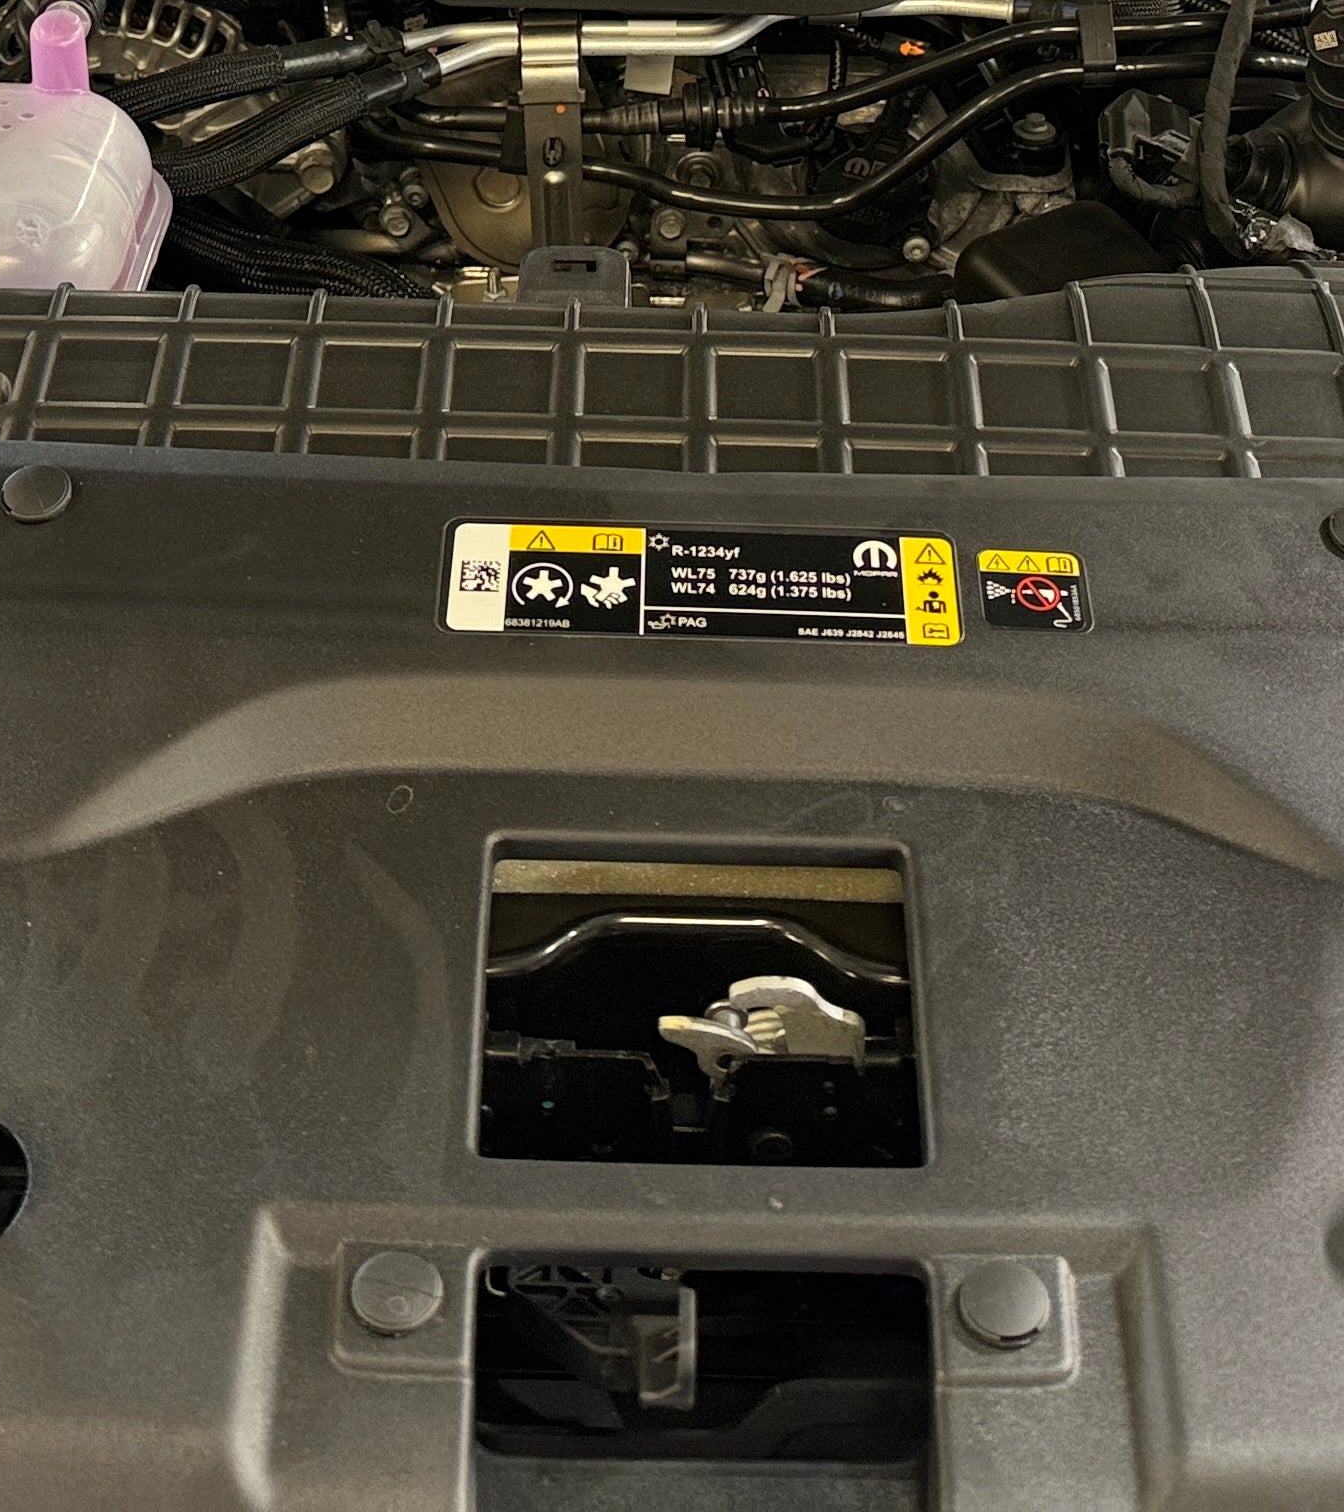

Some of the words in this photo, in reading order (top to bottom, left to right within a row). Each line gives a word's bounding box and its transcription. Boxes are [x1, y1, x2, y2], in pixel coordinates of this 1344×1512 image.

[671, 544, 741, 561] R-1234yf
[671, 566, 716, 580] WL75
[728, 568, 767, 584] 737g
[770, 570, 818, 584] (1.625
[821, 571, 852, 587] lbs)
[853, 569, 899, 579] MOPAR
[670, 581, 716, 595] WL74
[728, 583, 767, 599] 624g
[770, 585, 819, 599] (1.375
[821, 586, 853, 602] lbs)
[677, 616, 708, 629] PAG
[797, 627, 819, 637] SAE
[820, 628, 845, 637] J639
